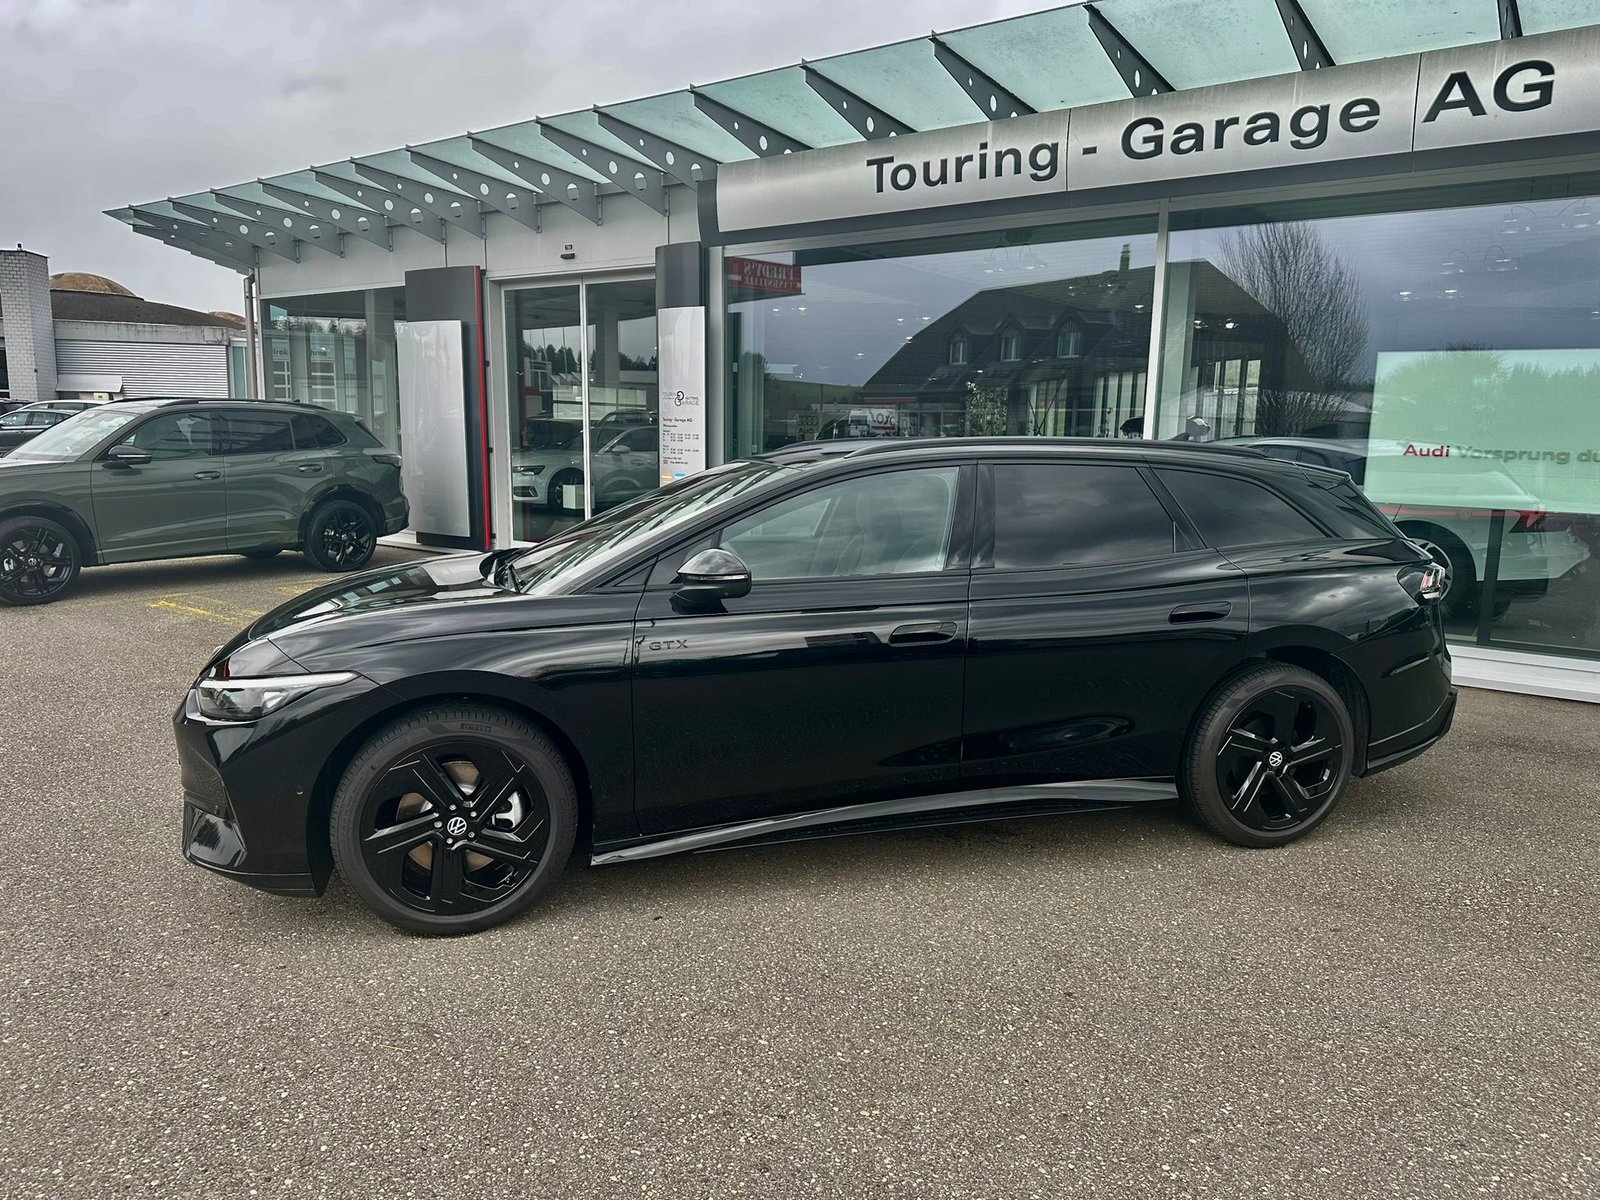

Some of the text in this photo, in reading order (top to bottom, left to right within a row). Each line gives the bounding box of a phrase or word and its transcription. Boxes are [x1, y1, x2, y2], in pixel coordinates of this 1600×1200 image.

[866, 59, 1557, 194] Touring - Garage AG
[1403, 444, 1450, 458] Audi
[1456, 445, 1571, 465] Vorsprung
[649, 639, 688, 651] GTX
